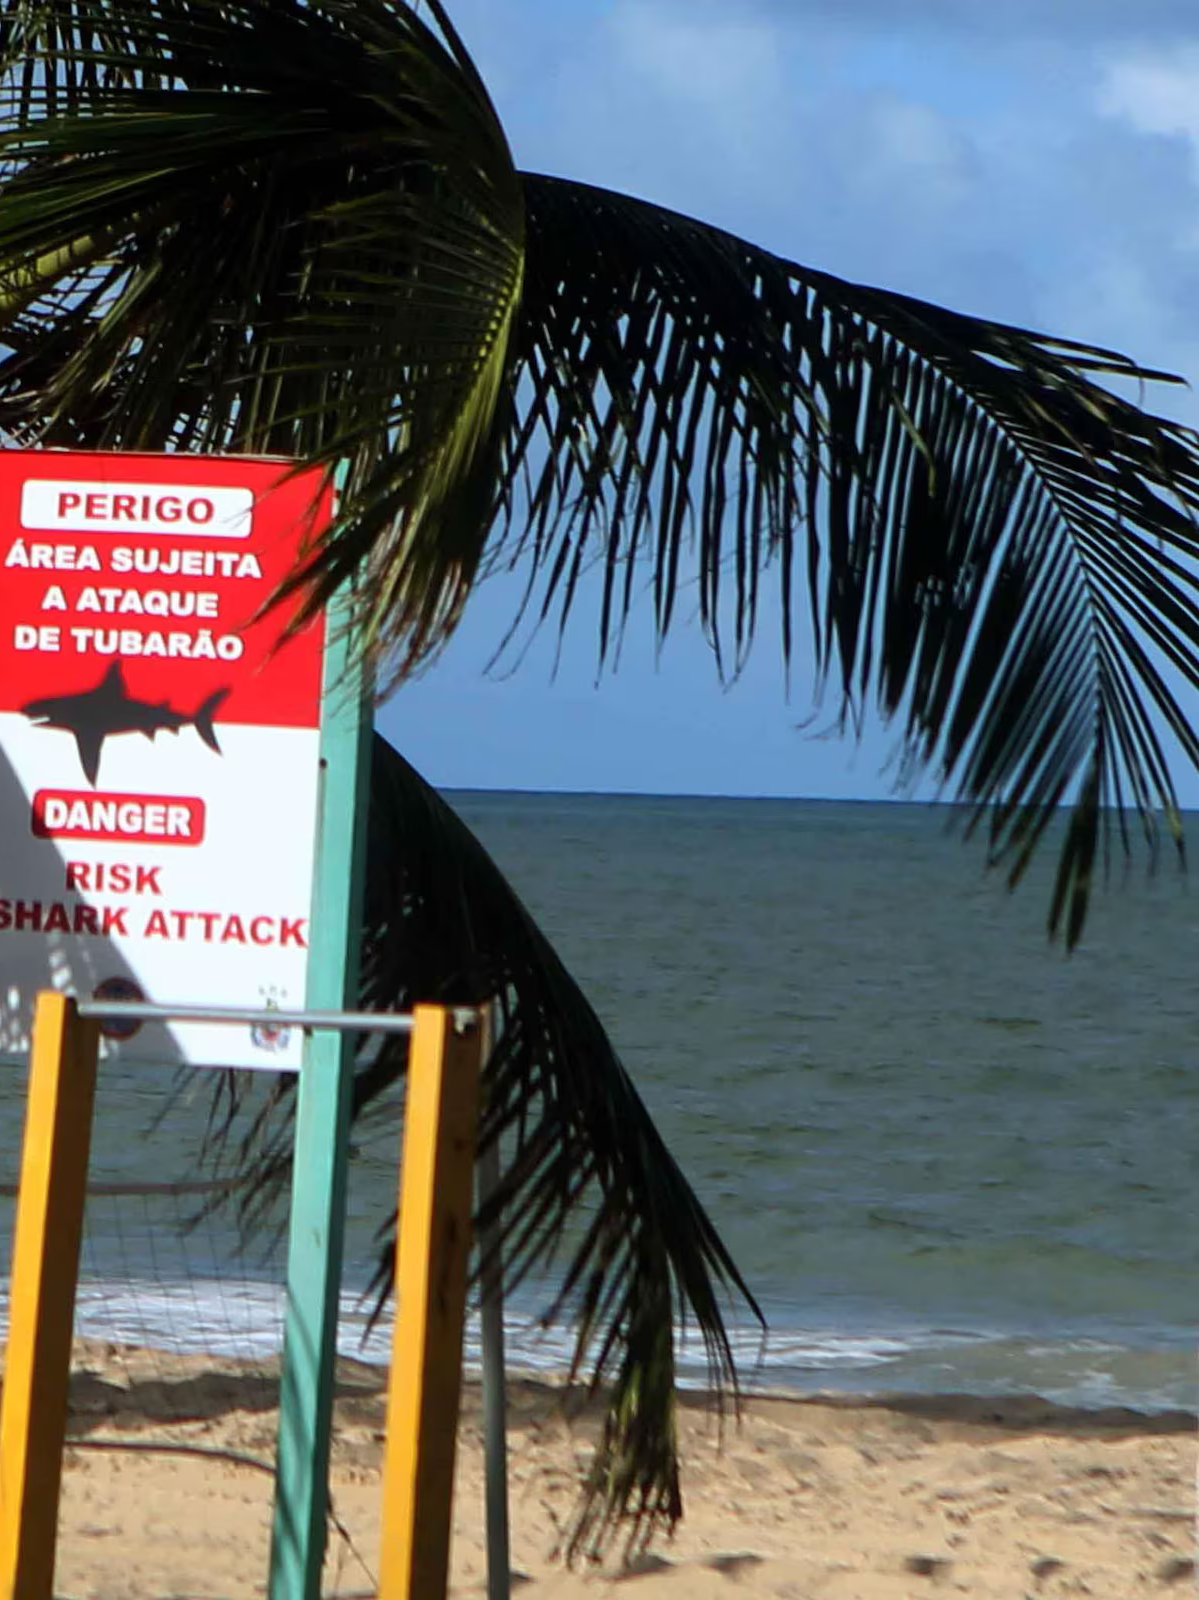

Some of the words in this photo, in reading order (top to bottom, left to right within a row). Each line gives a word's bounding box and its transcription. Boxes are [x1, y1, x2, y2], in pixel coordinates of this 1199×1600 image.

[57, 492, 214, 524] PERIGO
[5, 538, 101, 571] ÁREA
[110, 547, 262, 579] SUJEITA
[41, 586, 67, 611] A
[76, 588, 219, 618] ATAQUE
[14, 624, 60, 651] DE
[71, 628, 244, 660] TUBARÃO
[43, 799, 191, 837] DANGER
[65, 861, 163, 895] RISK
[143, 909, 309, 948] ATTACK
